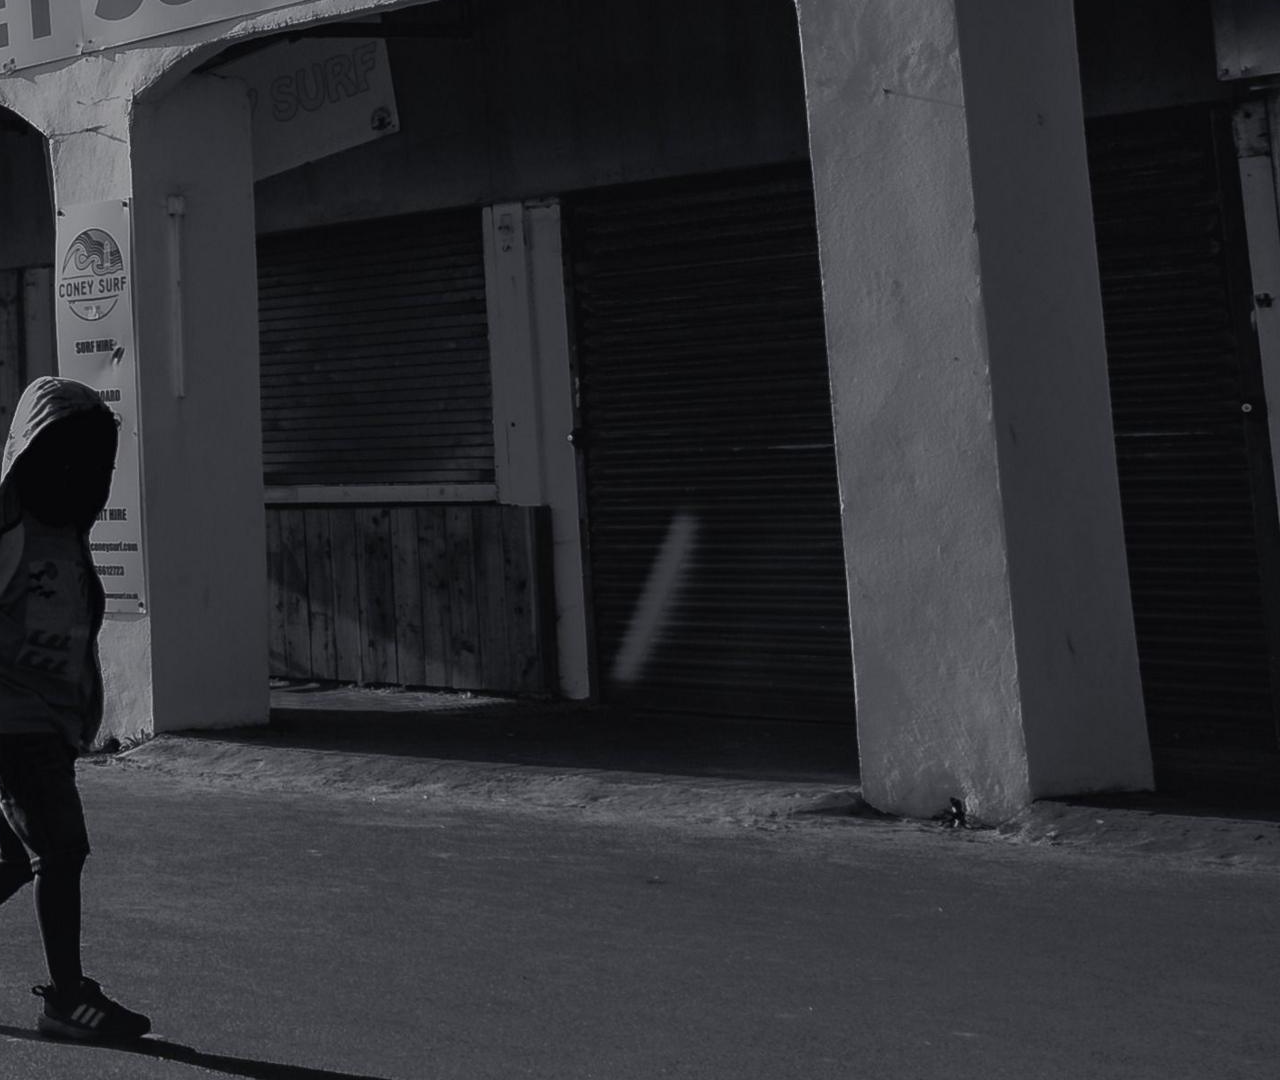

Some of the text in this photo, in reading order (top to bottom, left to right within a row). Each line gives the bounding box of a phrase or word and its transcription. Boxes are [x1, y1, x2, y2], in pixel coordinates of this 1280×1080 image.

[270, 40, 377, 123] SURF
[58, 276, 128, 298] CONEY SURF
[75, 338, 115, 354] SURF HIRE
[109, 508, 127, 521] HIRE
